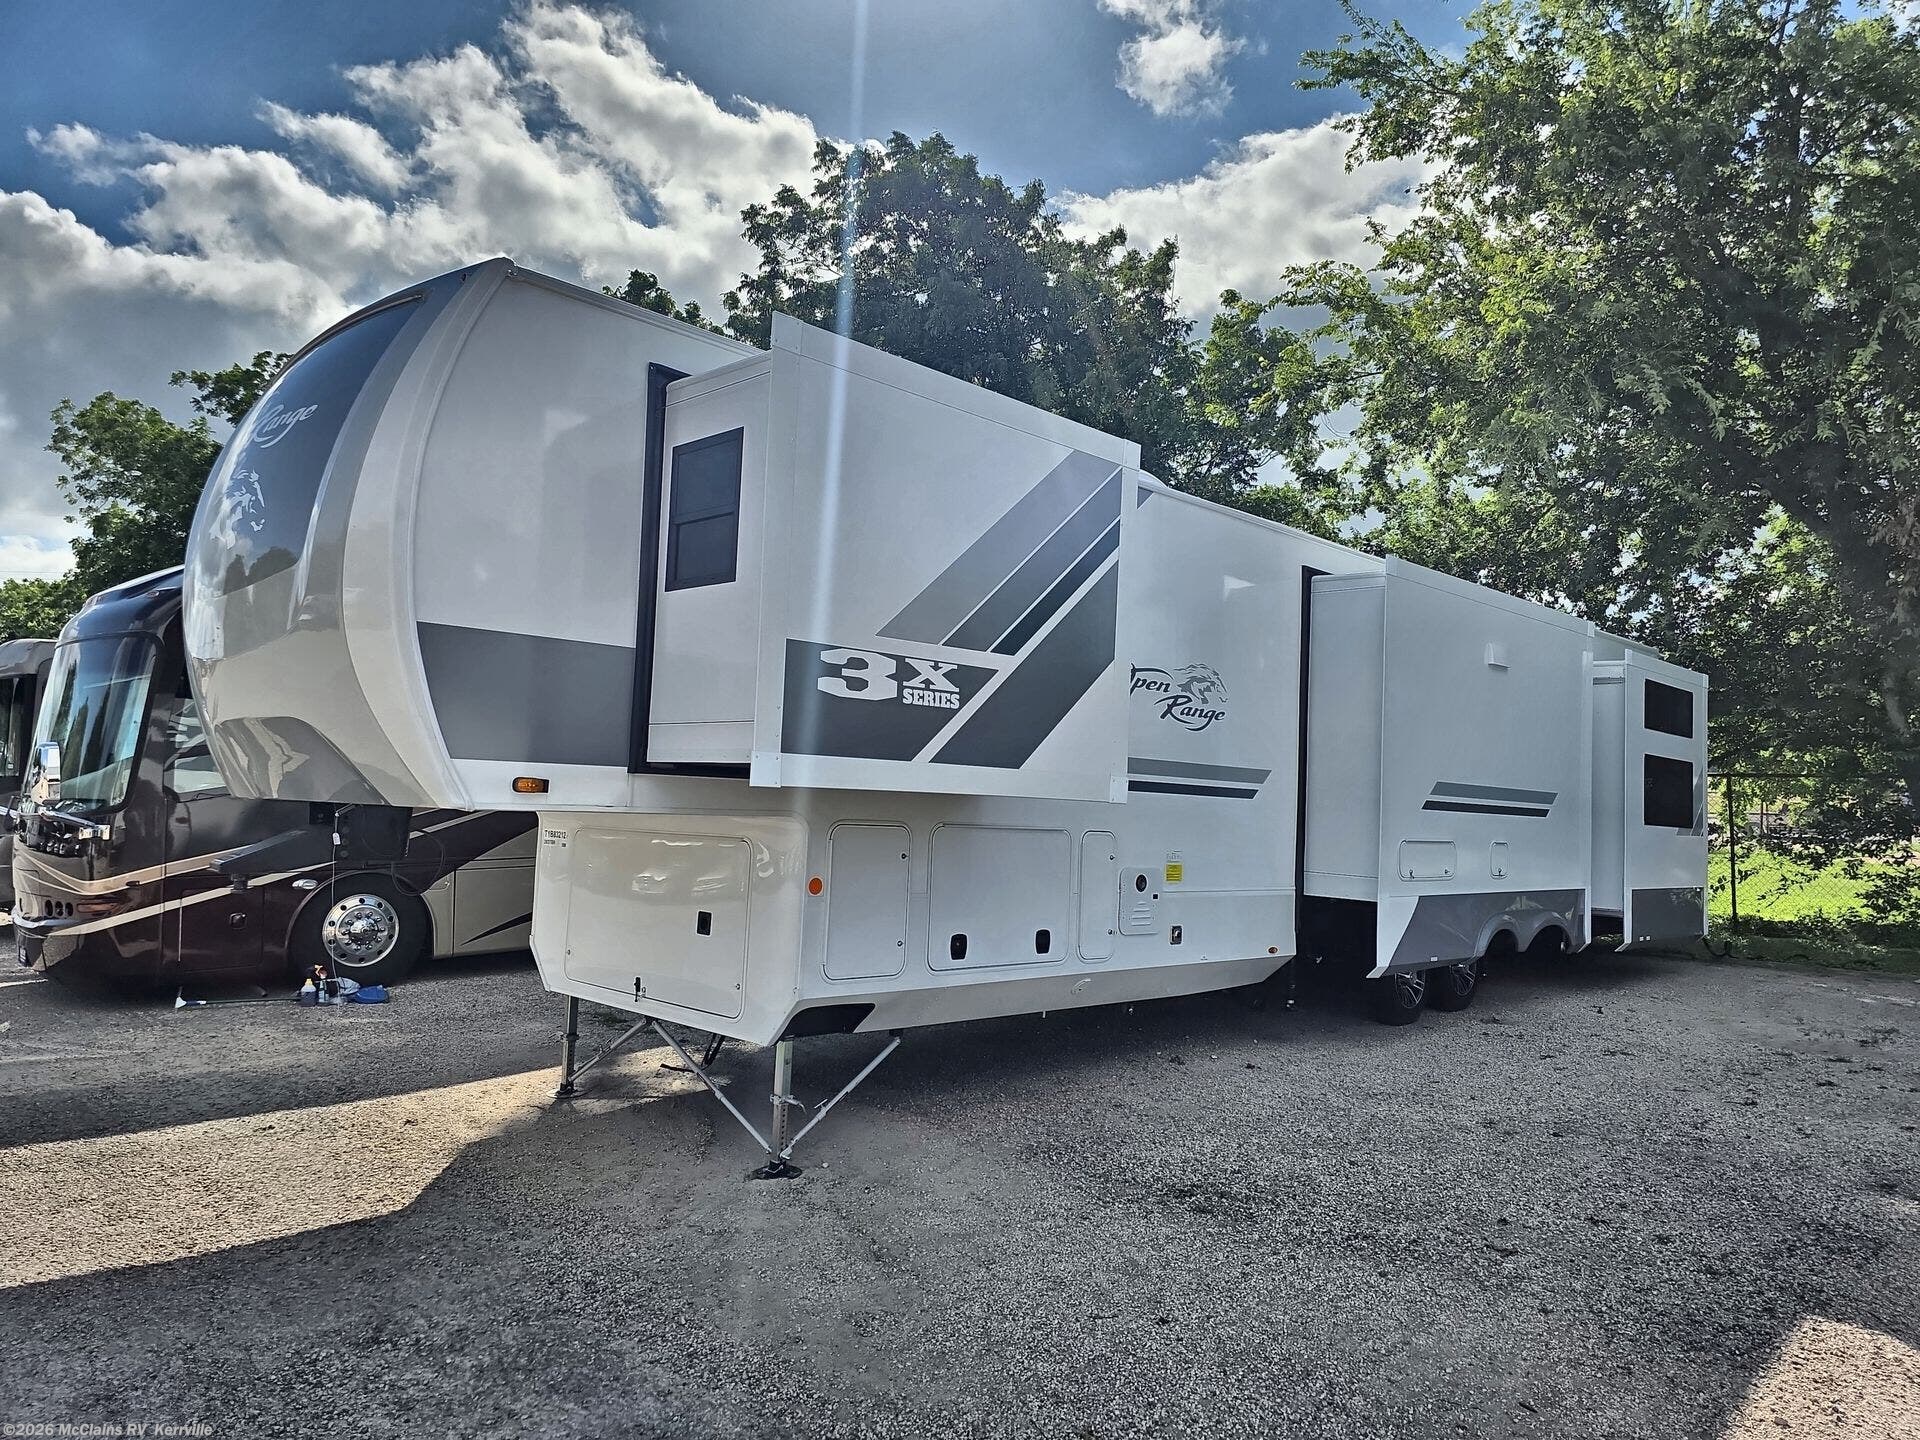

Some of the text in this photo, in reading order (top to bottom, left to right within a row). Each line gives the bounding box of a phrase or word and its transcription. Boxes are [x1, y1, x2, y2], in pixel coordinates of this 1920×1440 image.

[1130, 662, 1174, 696] pen
[902, 688, 960, 710] SERIES
[1153, 694, 1226, 732] Range
